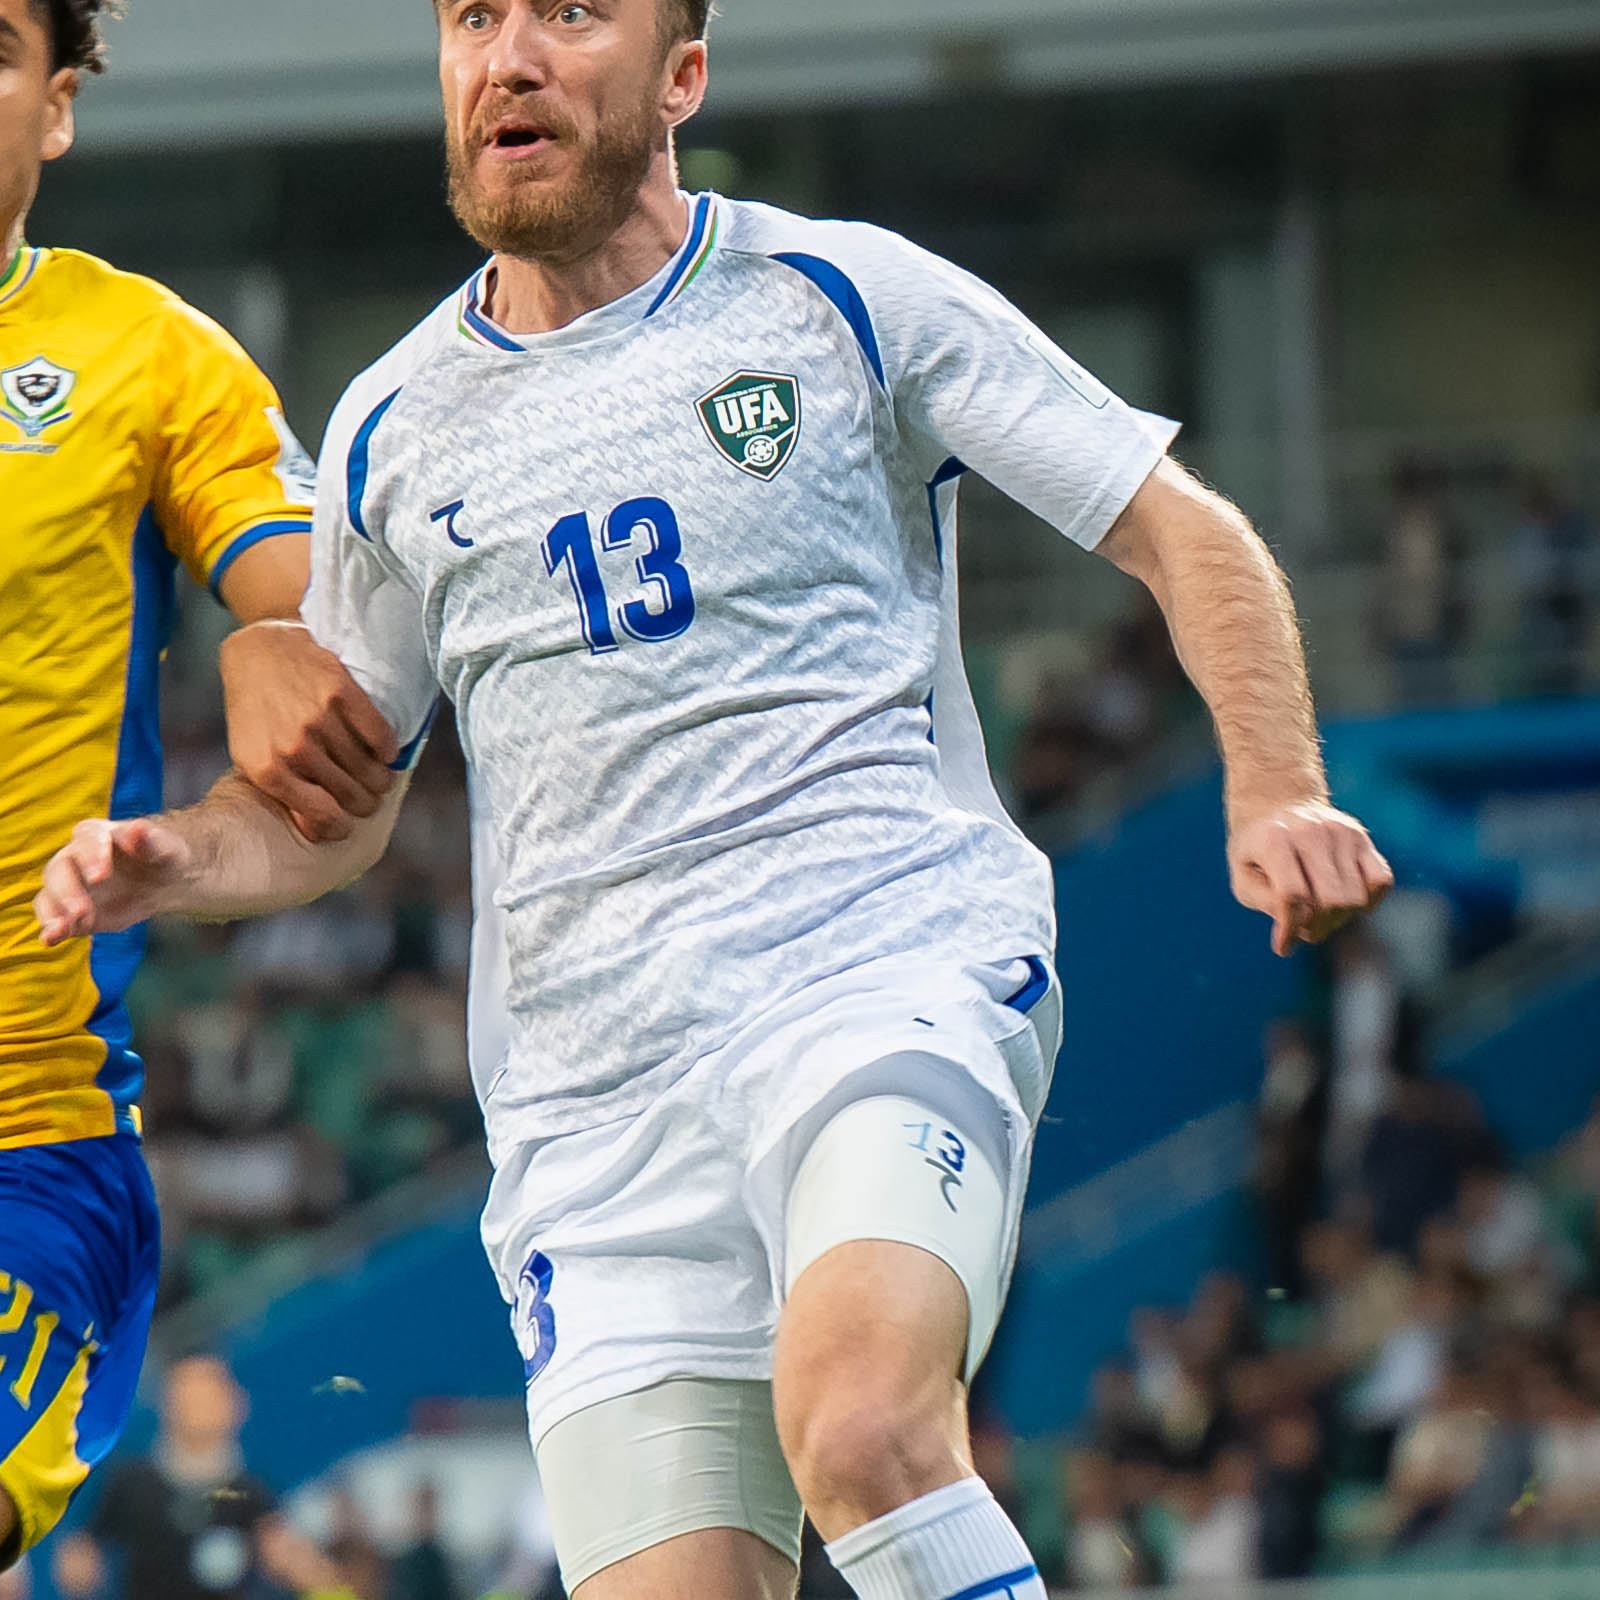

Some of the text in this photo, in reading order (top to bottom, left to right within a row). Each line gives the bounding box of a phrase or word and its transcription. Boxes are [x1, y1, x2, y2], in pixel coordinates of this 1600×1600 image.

[714, 389, 789, 434] UFA
[540, 496, 696, 656] 13
[902, 1122, 966, 1173] 13
